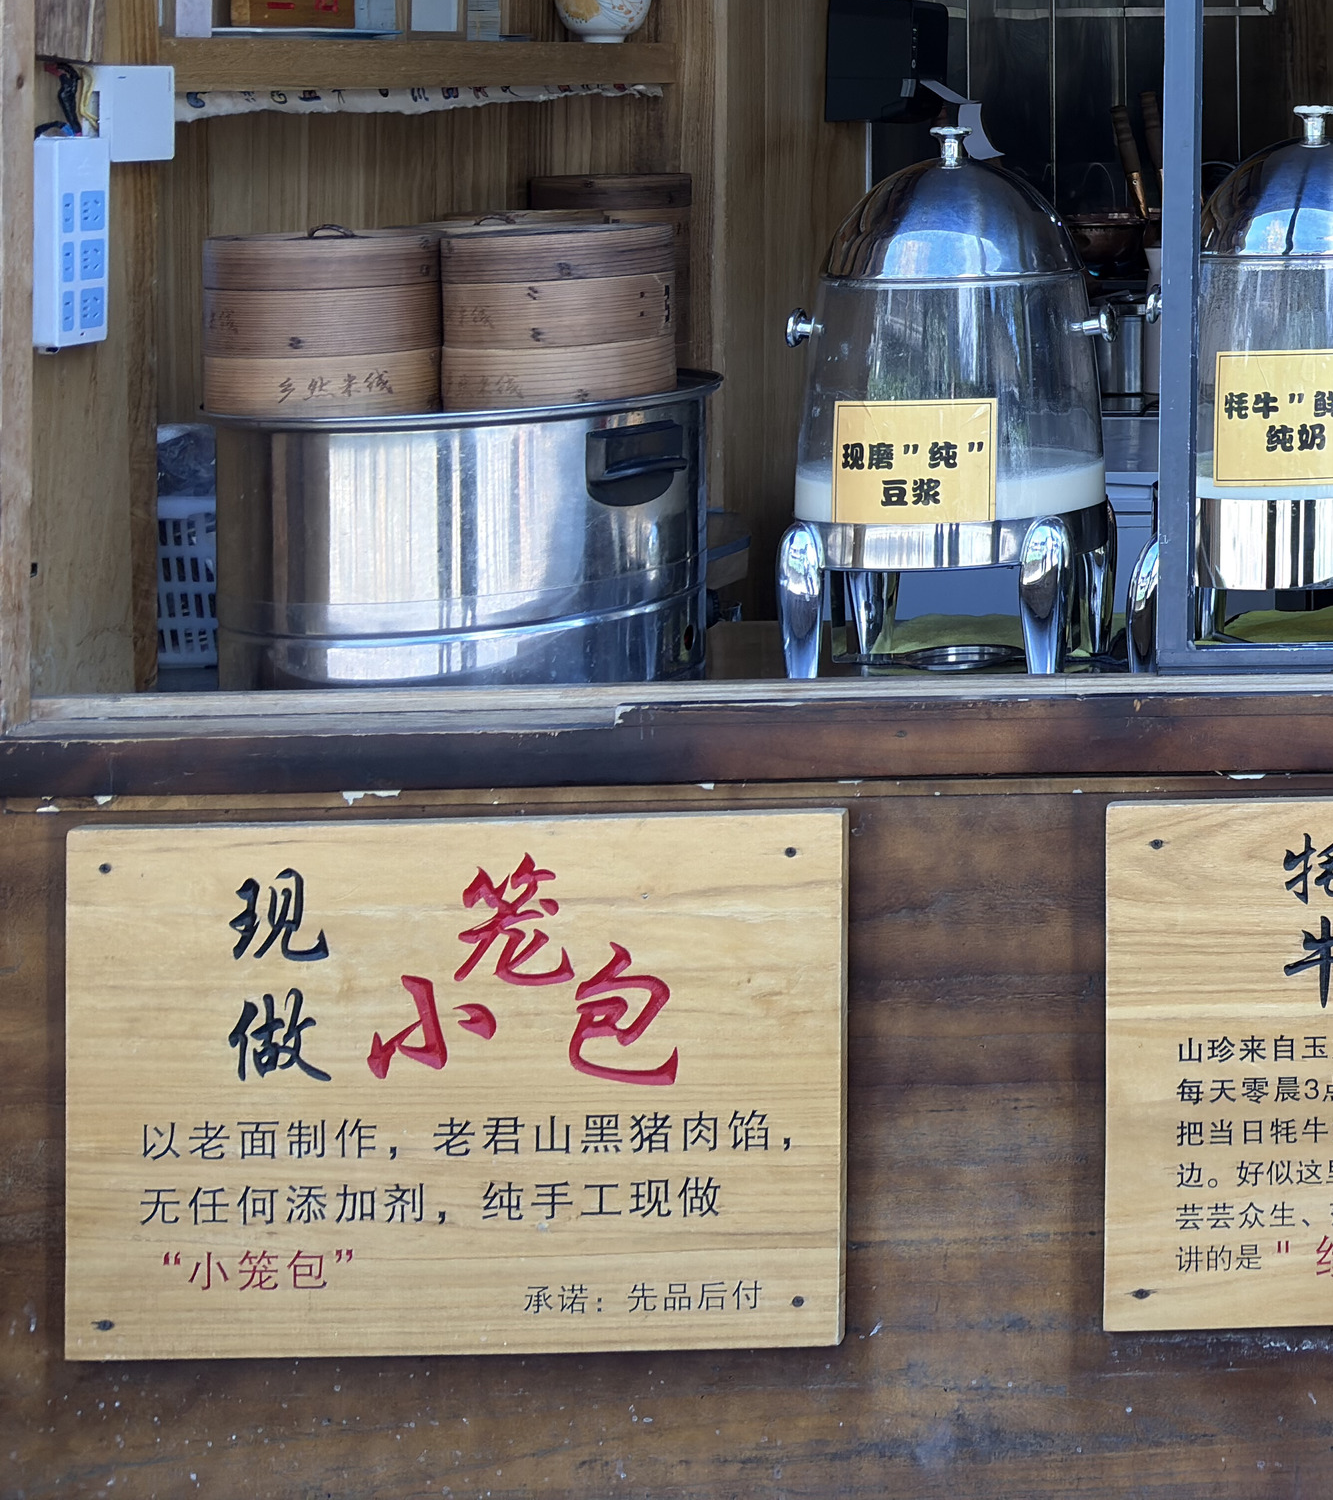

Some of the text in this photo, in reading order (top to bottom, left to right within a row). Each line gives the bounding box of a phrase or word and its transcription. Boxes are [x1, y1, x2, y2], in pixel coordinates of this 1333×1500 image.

[278, 368, 394, 403] 乡然米线
[1265, 423, 1328, 453] 纯奶
[879, 478, 942, 508] 豆浆
[139, 1176, 722, 1228] 无任何添加剂，纯手工现做
[162, 1247, 356, 1293] “小笼包”
[523, 1280, 765, 1317] 承诺：先品后付
